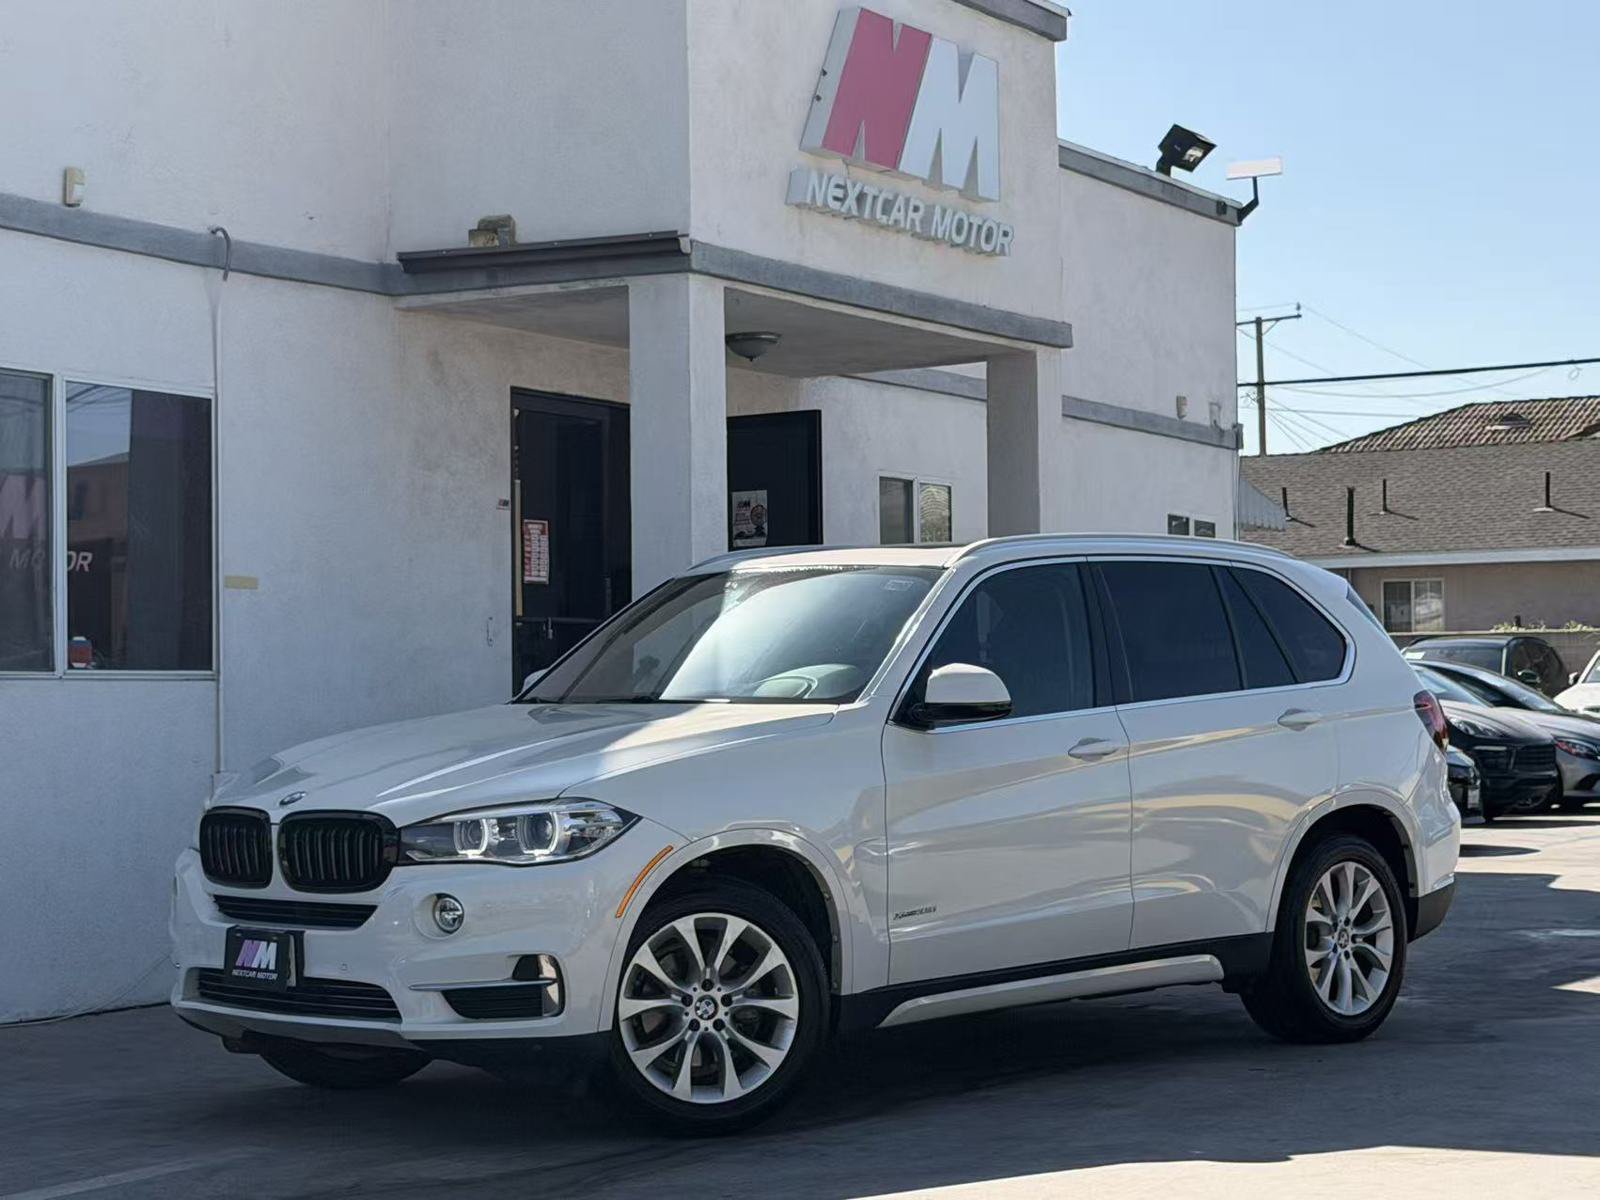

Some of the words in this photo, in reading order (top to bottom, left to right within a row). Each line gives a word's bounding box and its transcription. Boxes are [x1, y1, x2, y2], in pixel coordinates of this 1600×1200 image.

[804, 169, 924, 234] NEXTCAR
[930, 203, 1015, 257] MOTOR
[232, 969, 256, 978] NEXTCAR
[257, 971, 278, 980] MOTOR
